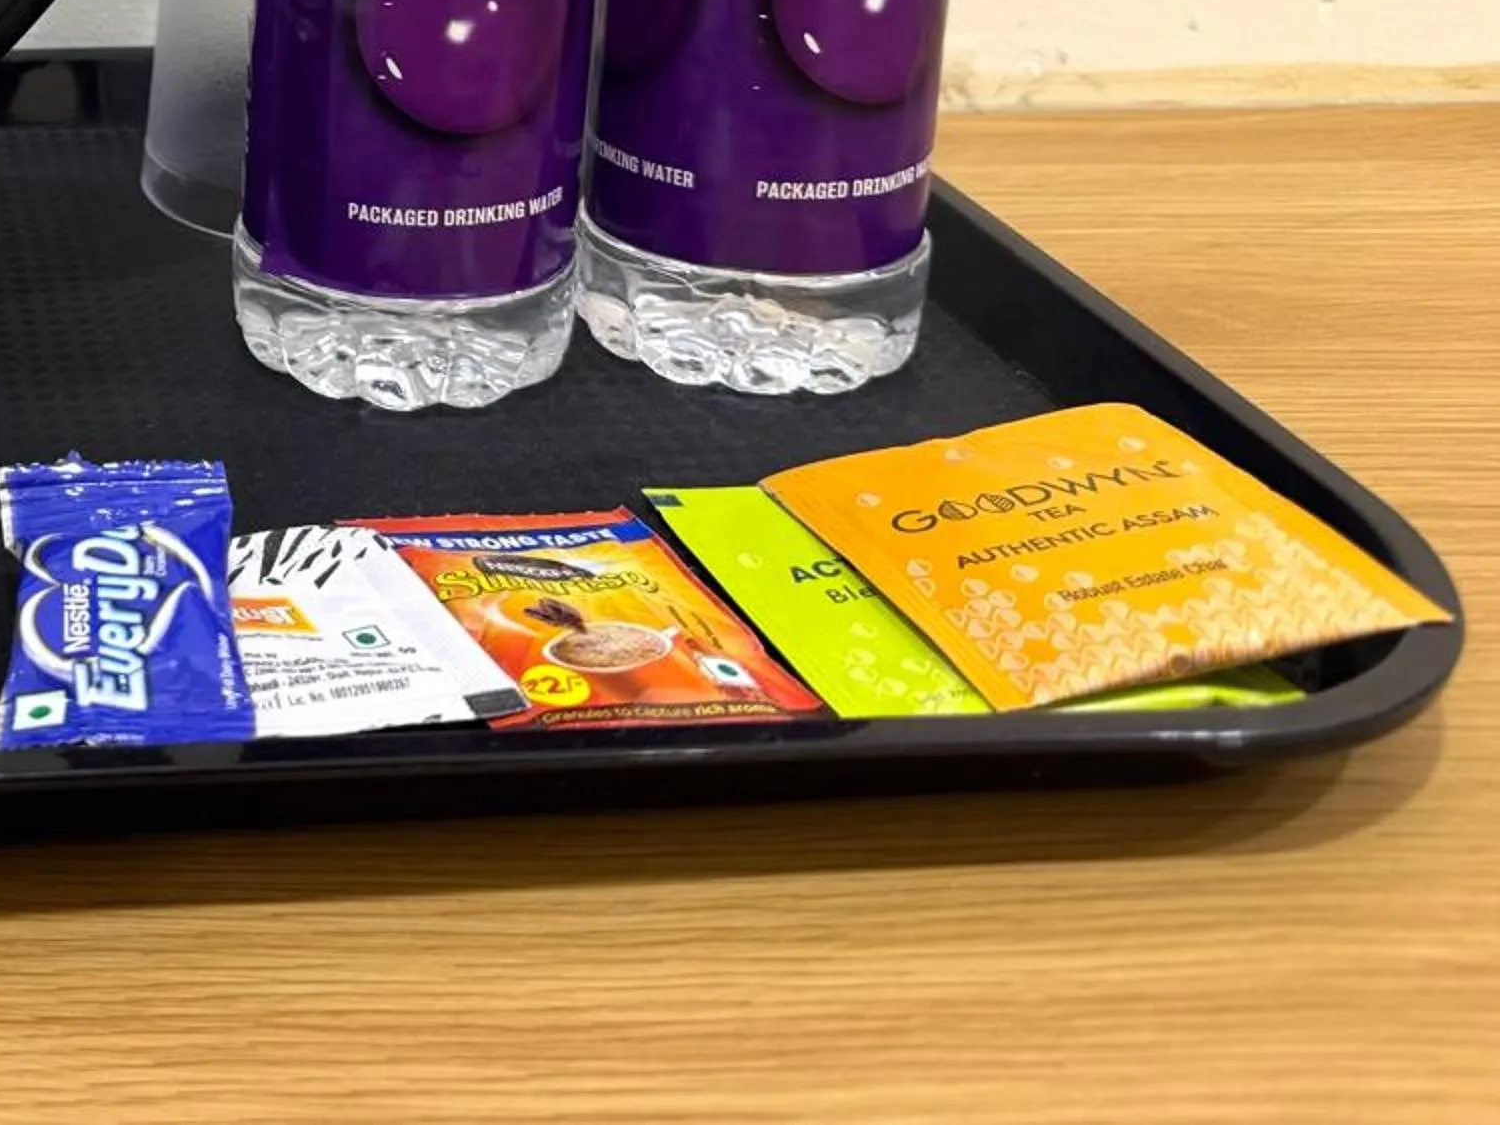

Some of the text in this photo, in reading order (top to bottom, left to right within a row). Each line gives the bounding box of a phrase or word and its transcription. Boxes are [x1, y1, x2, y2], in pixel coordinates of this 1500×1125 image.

[598, 141, 695, 189] INKING WATER
[756, 180, 850, 201] PACKAGED
[852, 166, 915, 197] DRINKING
[348, 185, 564, 227] PACKAGED DRINKING WATER
[1027, 503, 1088, 523] TEA
[436, 533, 538, 551] STRONG
[539, 527, 618, 548] TASTE
[955, 504, 1219, 569] AUTHENTIC ASSAM
[790, 556, 844, 584] AC
